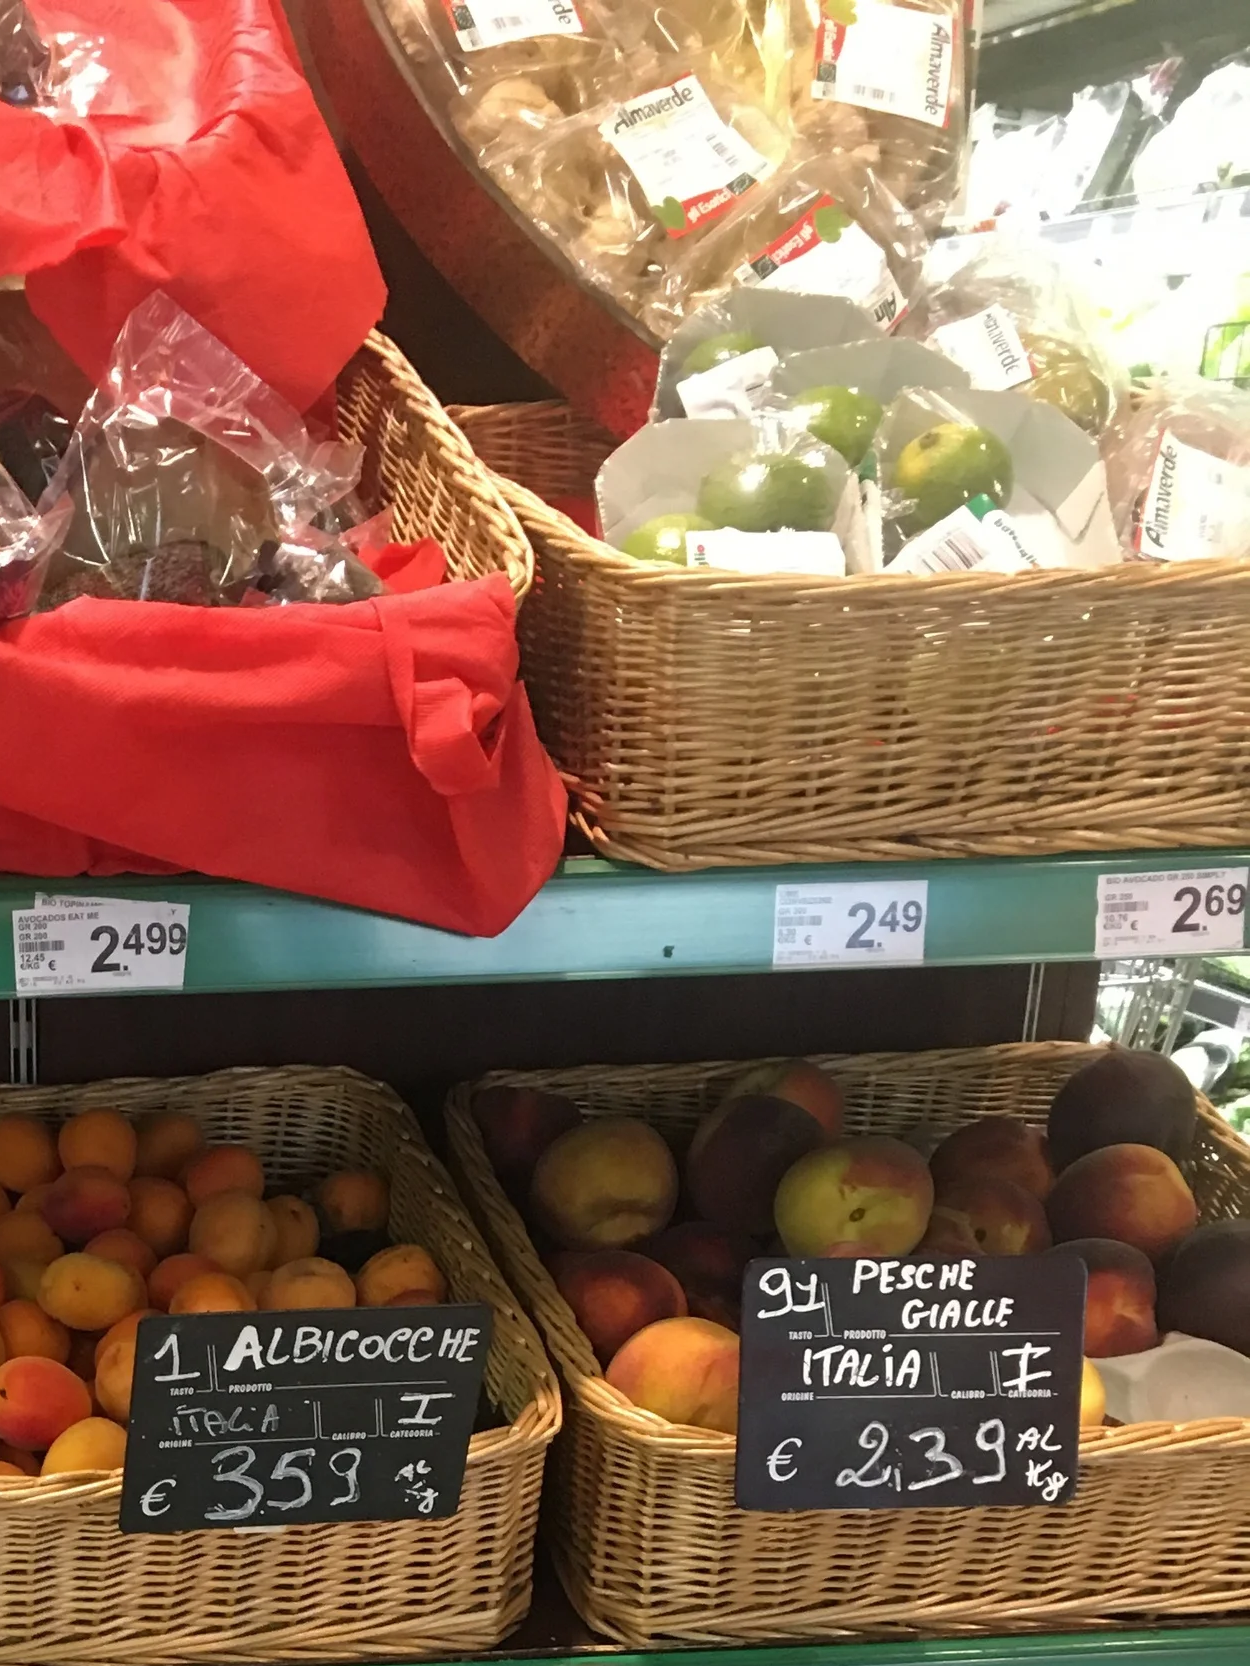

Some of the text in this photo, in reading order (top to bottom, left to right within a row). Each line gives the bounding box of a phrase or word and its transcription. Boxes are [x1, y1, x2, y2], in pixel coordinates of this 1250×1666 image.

[614, 85, 694, 134] Almaverde
[1171, 883, 1246, 933] 2.69
[18, 912, 99, 923] AVOCADOS EAT ME
[846, 900, 922, 948] 2.49
[1130, 920, 1138, 930] €
[18, 922, 32, 931] GR
[19, 932, 32, 941] GR
[20, 953, 45, 962] 12.45
[48, 960, 56, 971] €
[852, 1259, 976, 1295] PESCHE
[901, 1298, 1014, 1330] GIALLE
[789, 1330, 887, 1341] TASTO PRODOTTO
[153, 1325, 481, 1383] 1 ALBICOCCHE
[170, 1383, 273, 1396] TASTO PRODOTTO
[781, 1392, 814, 1402] ORIGINE
[951, 1390, 985, 1400] CALIBRO
[159, 1429, 434, 1449] ORIGINE CALIBRO CATEGORIA
[766, 1418, 1062, 1492] € 2,39 AL
[139, 1479, 177, 1517] €
